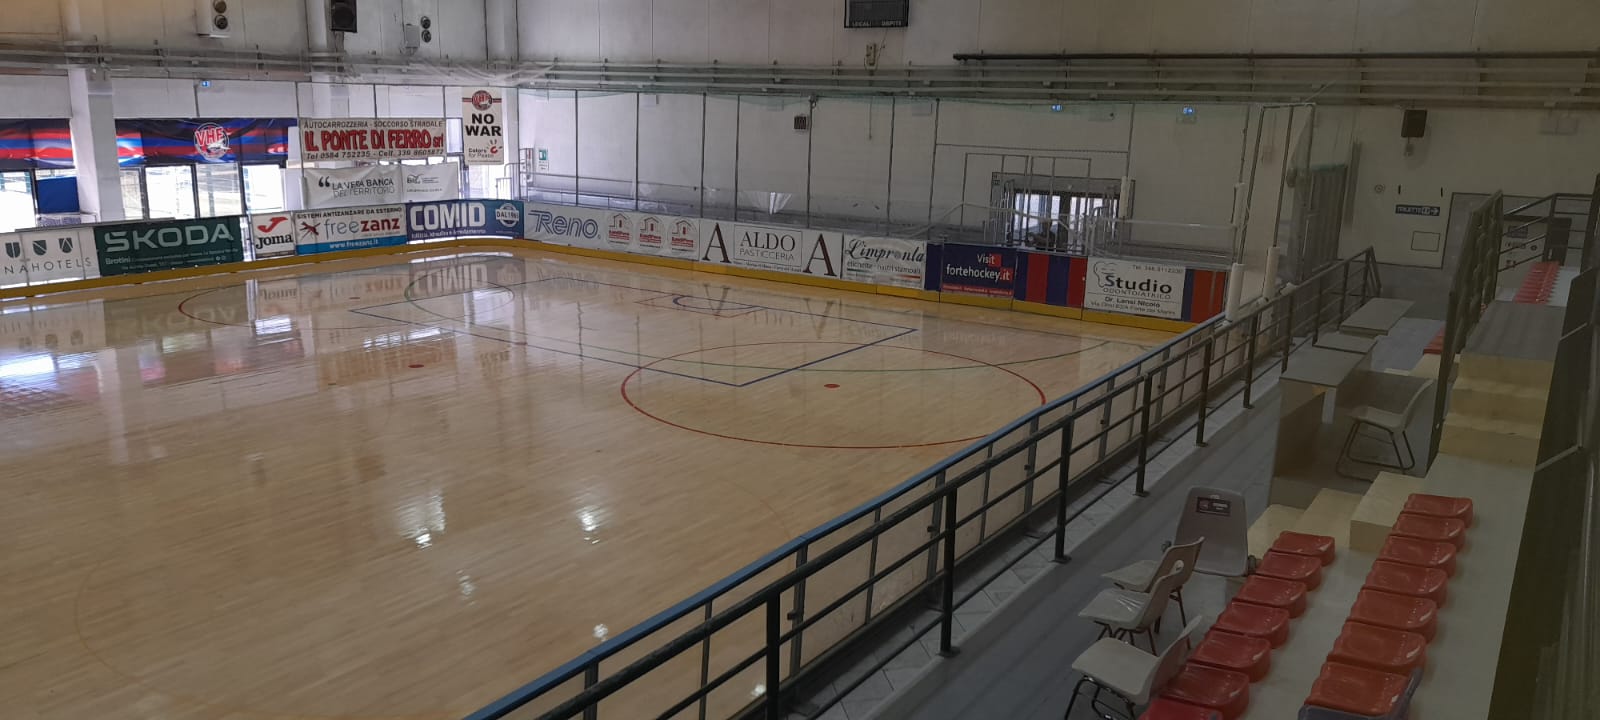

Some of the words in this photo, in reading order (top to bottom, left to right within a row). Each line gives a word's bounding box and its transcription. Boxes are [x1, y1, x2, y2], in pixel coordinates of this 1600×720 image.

[304, 120, 368, 129] AUTOCARROZZERIA
[374, 119, 409, 128] SOCCORSO
[409, 119, 444, 128] STRADALE
[471, 113, 495, 125] NO
[194, 126, 224, 147] VHF
[304, 131, 319, 152] IL
[321, 130, 369, 151] PONTE
[370, 130, 386, 150] DI
[387, 129, 432, 149] FERRO
[465, 125, 502, 137] WAR
[366, 178, 394, 187] BANCA
[297, 211, 322, 219] SISTEMI
[322, 209, 365, 218] ANTIZANZARE
[410, 202, 486, 231] COMID
[528, 209, 599, 239] Reno
[323, 218, 401, 241] freezanz
[702, 222, 731, 263] A
[740, 231, 796, 252] ALDO
[740, 248, 794, 261] PASTICCERIA
[802, 233, 837, 277] A
[977, 253, 995, 265] Visit
[946, 263, 1010, 283] fortehockey.it
[1104, 274, 1172, 294] Studio
